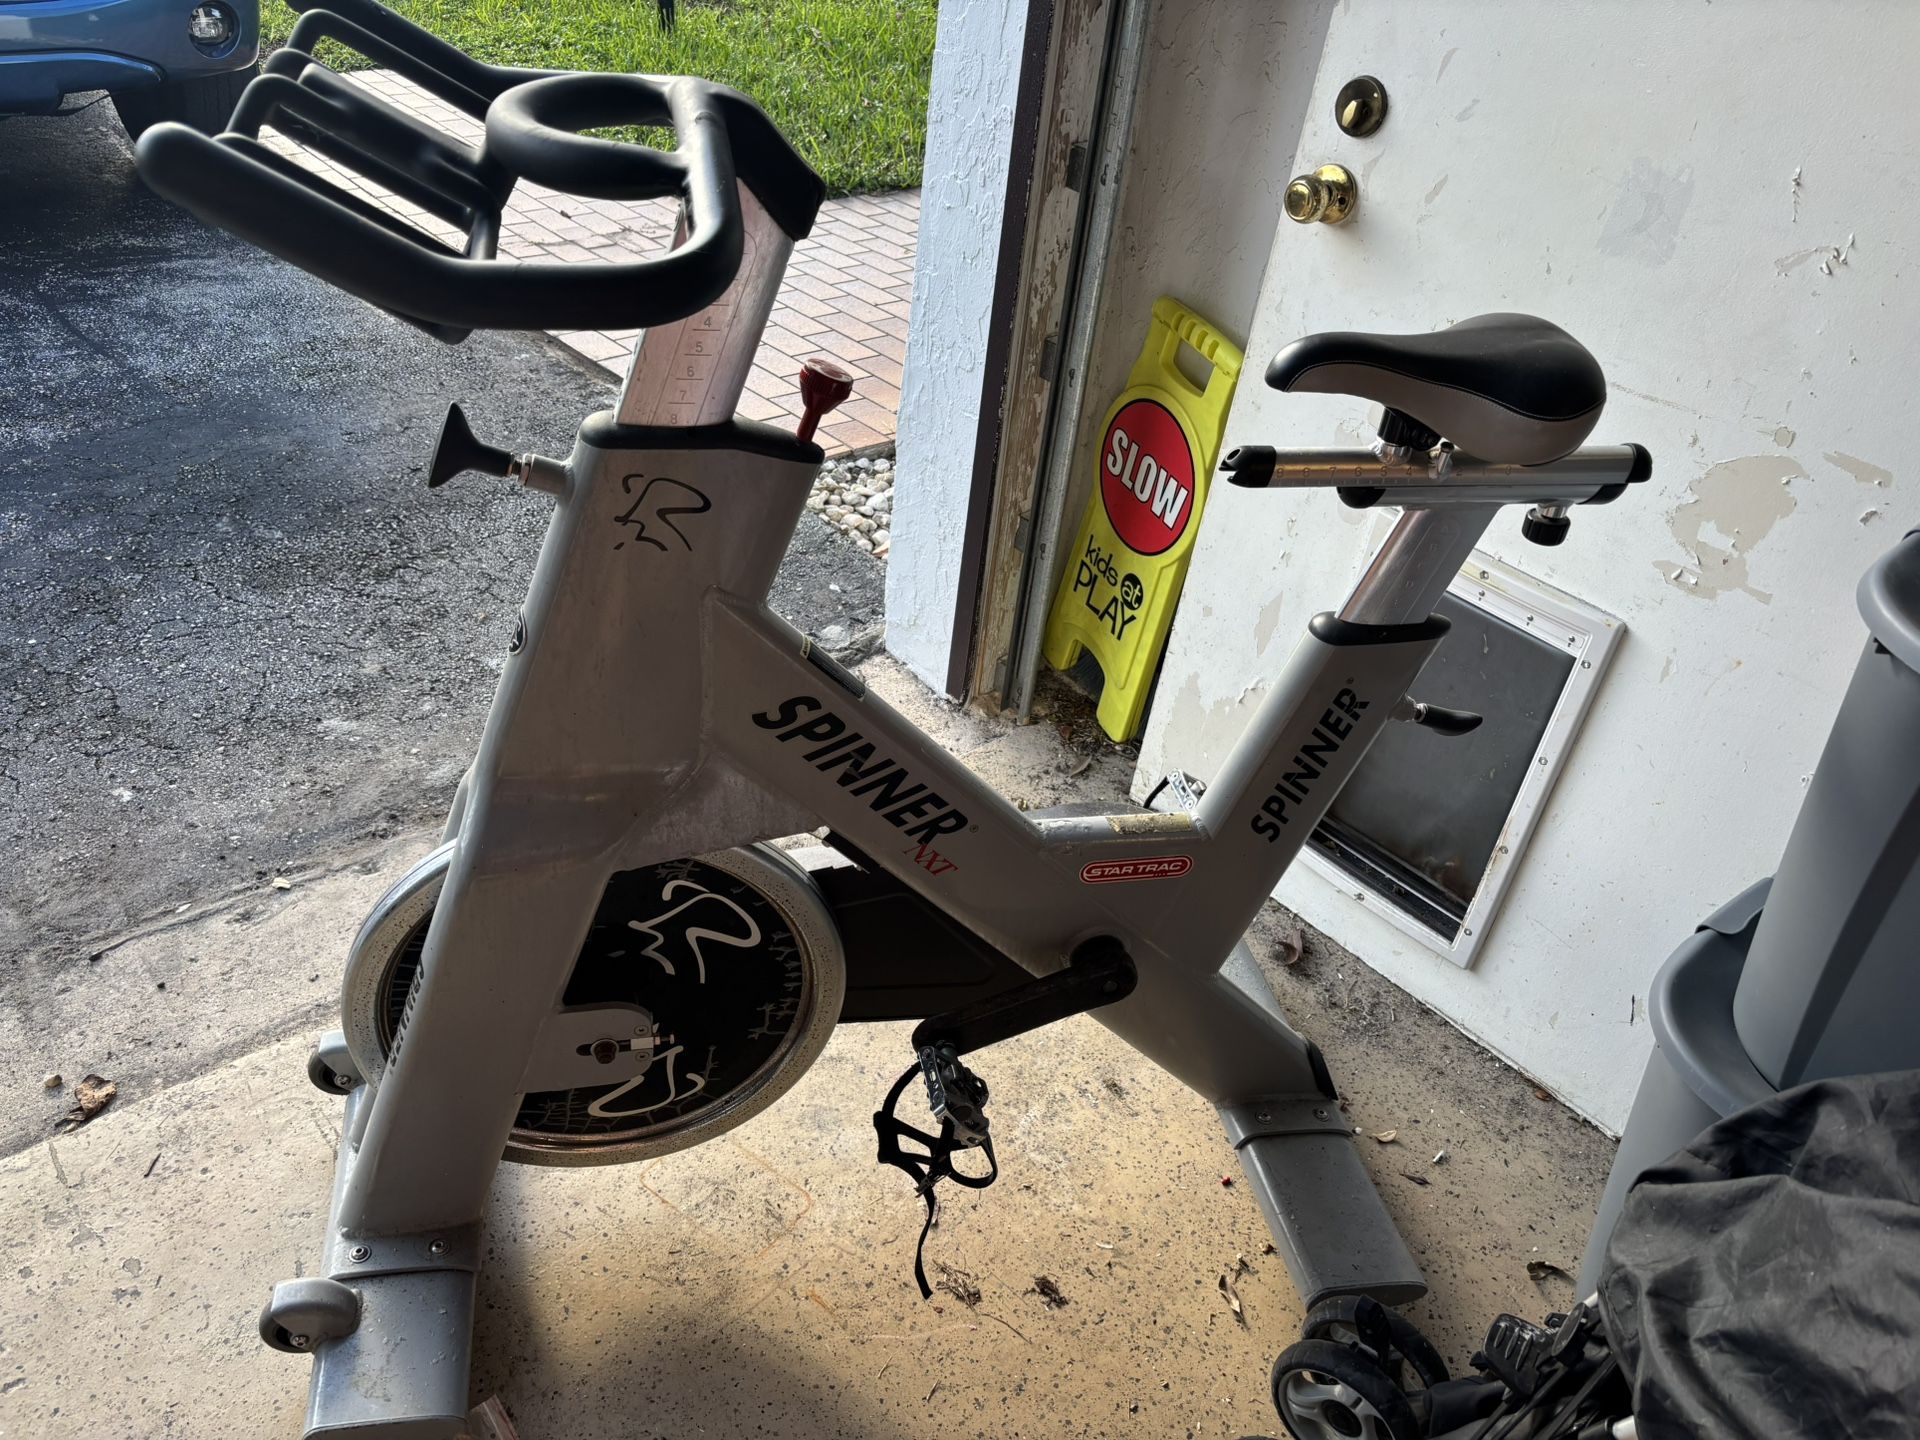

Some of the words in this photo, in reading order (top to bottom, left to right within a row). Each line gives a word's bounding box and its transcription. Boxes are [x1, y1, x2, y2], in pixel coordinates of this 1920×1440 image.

[703, 316, 712, 328] 4
[695, 342, 704, 353] 5
[686, 366, 695, 378] 6
[679, 390, 687, 401] 7
[670, 414, 678, 425] 8
[1106, 427, 1189, 530] SLOW
[1085, 534, 1118, 587] kids
[1121, 579, 1142, 608] at
[1073, 560, 1137, 641] PLAY
[1090, 865, 1134, 877] STAR
[1136, 862, 1183, 874] TRAC
